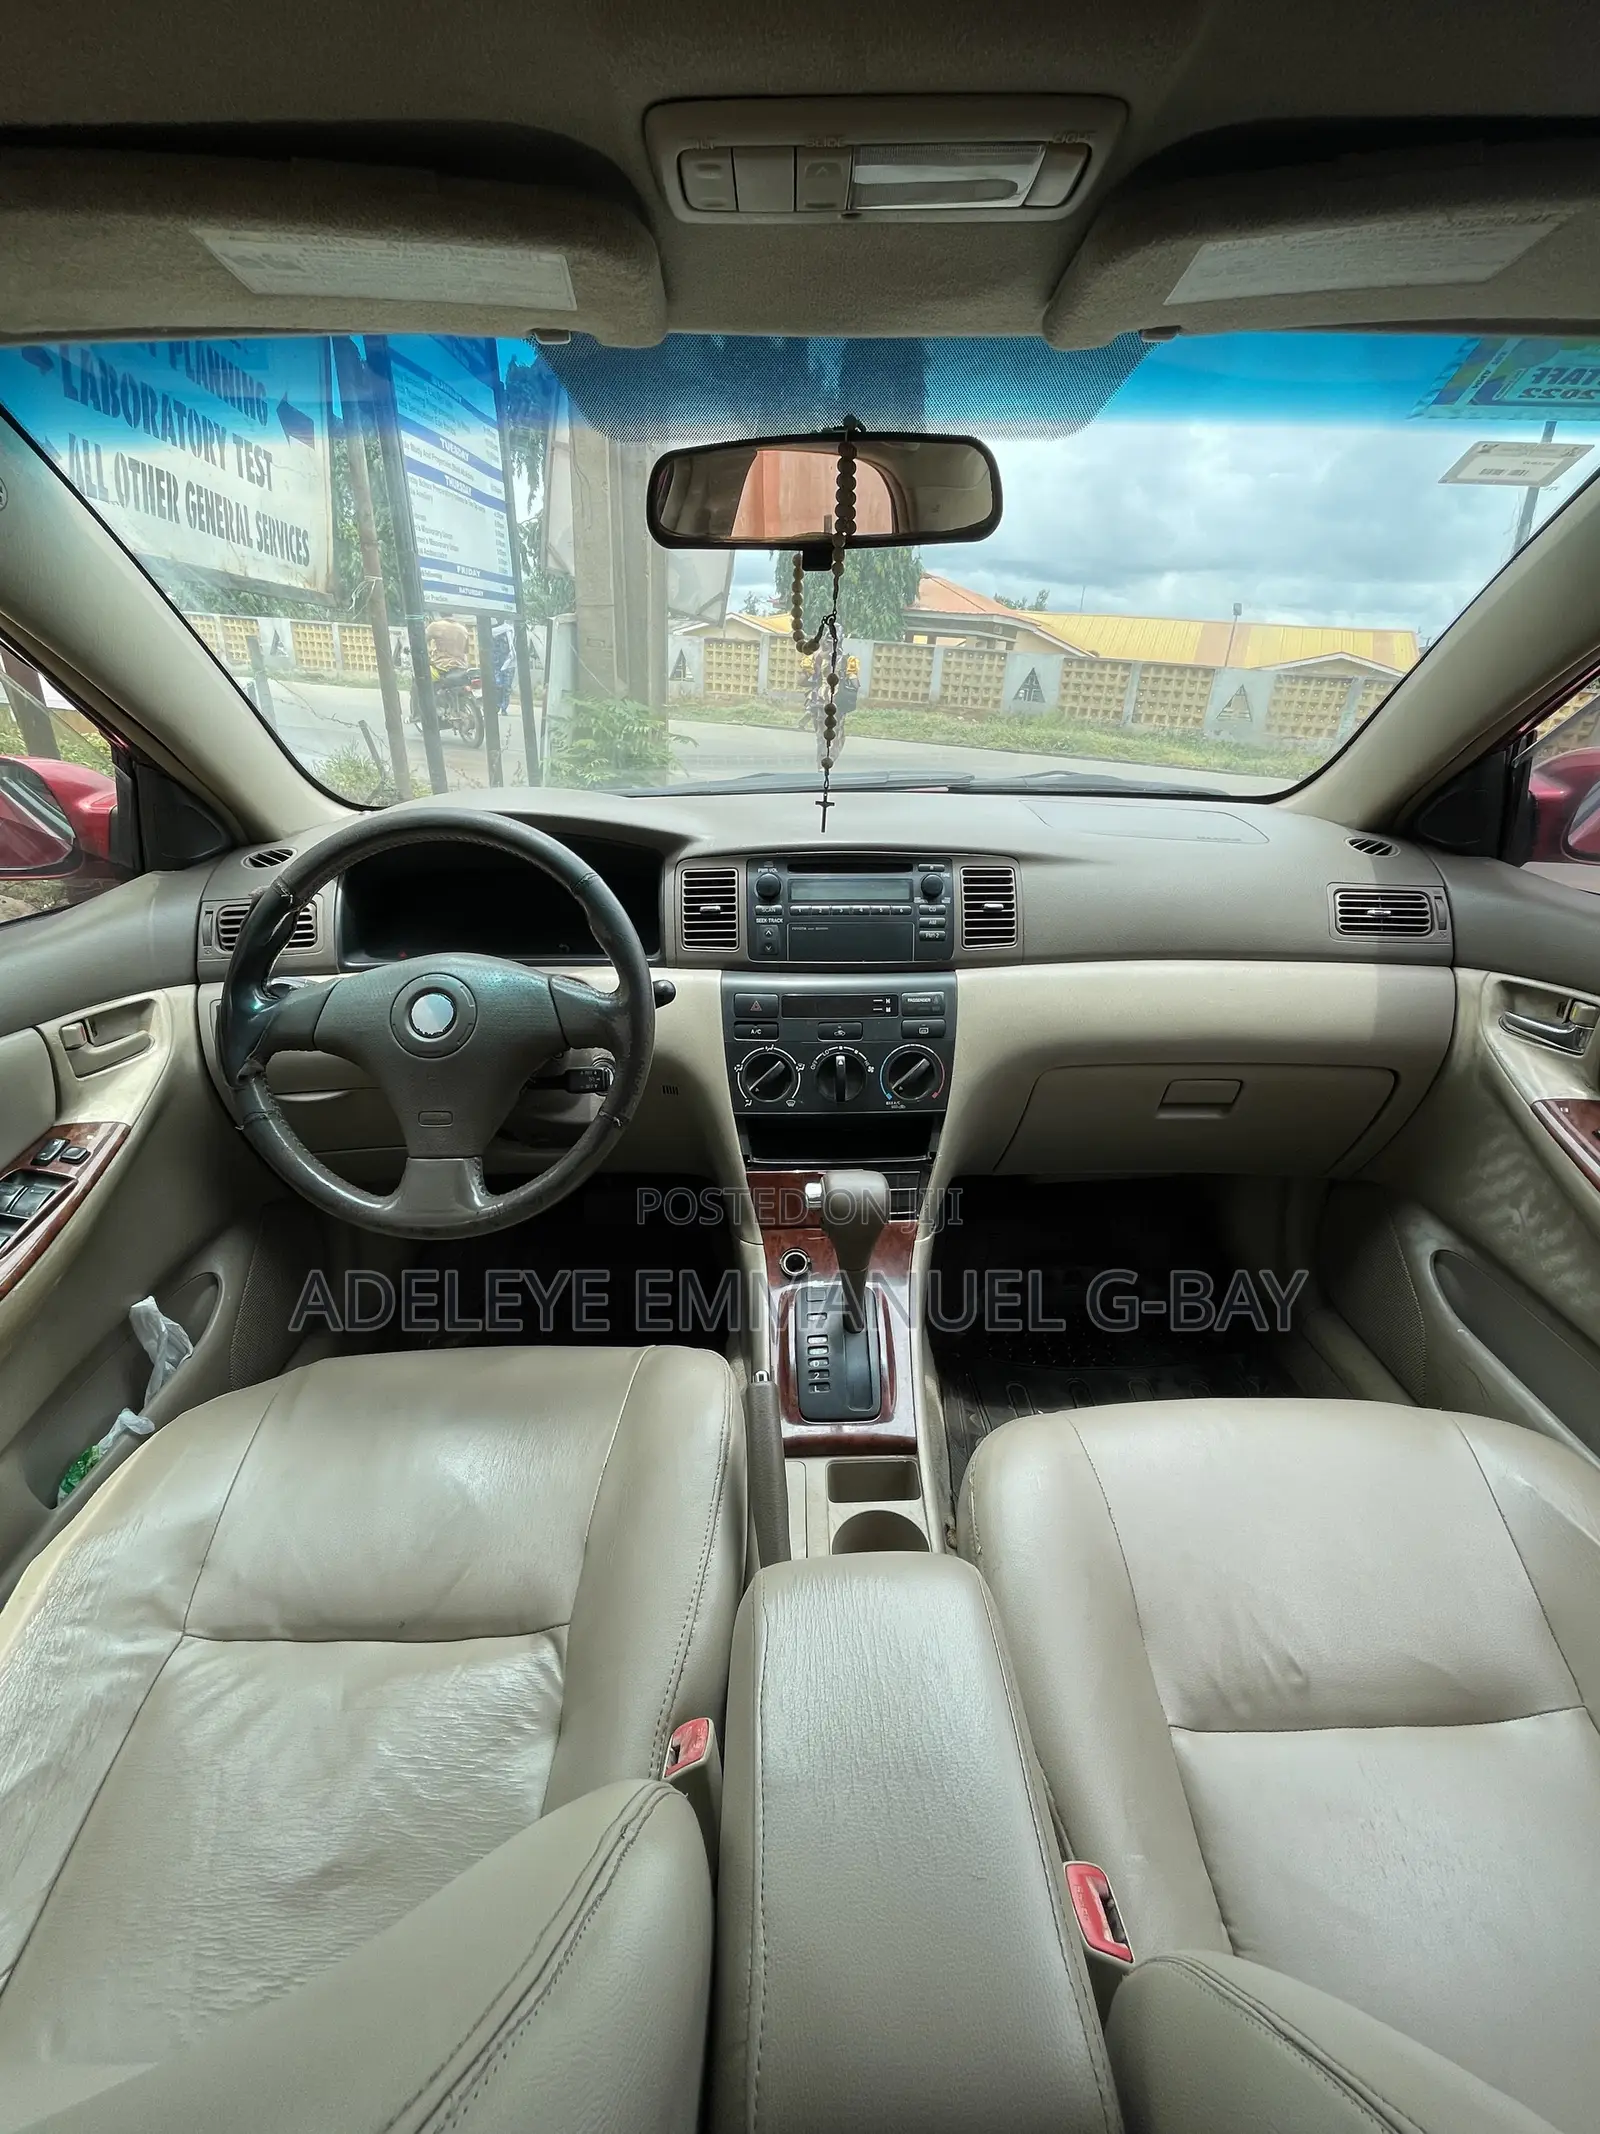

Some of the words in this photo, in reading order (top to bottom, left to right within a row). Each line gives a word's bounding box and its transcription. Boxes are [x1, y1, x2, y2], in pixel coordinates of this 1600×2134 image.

[59, 343, 227, 471] LABORATORY
[232, 432, 273, 492] TEST
[440, 437, 470, 462] TUESDAY
[68, 432, 109, 503] ALL
[114, 451, 180, 525] OTHER
[185, 480, 254, 549] GENERAL
[255, 510, 311, 567] SERVICES
[456, 565, 481, 578] FRIDAY
[821, 1049, 830, 1057] LO
[810, 1060, 818, 1071] OFF
[814, 1372, 820, 1380] 2
